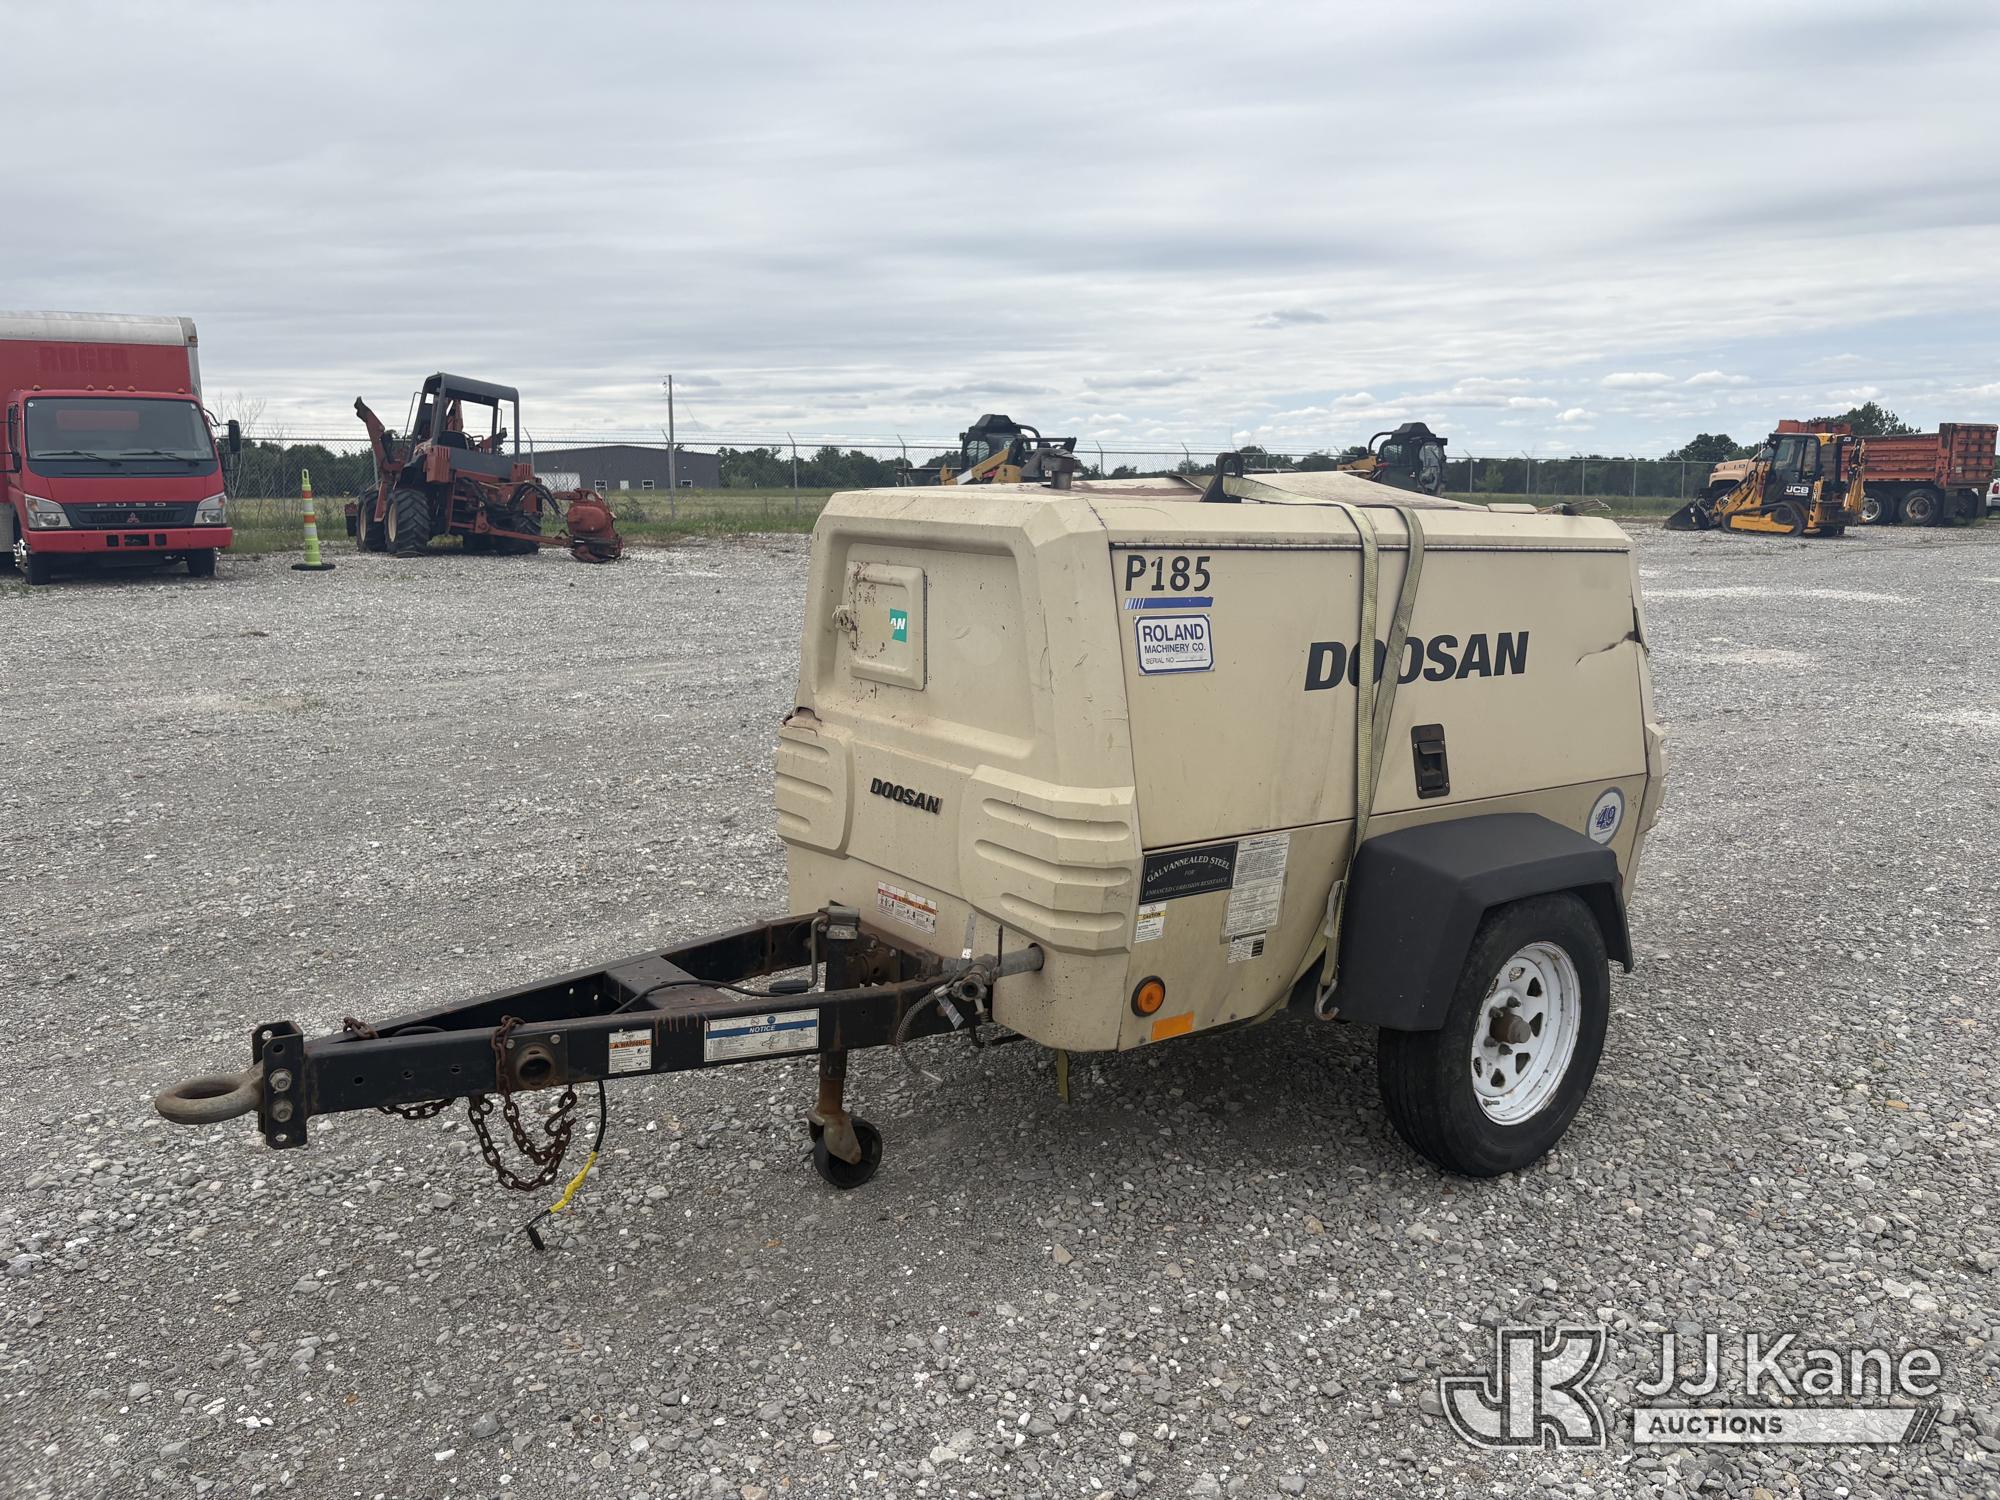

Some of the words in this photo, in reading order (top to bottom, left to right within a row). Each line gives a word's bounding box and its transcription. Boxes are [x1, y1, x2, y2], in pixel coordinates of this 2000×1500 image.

[1785, 485, 1809, 494] JCB
[1125, 554, 1211, 592] P185
[1142, 623, 1204, 643] ROLAND
[1144, 642, 1190, 654] MACHINERY
[1192, 642, 1206, 652] CO.
[1145, 657, 1165, 665] SERIAL
[869, 777, 943, 814] DOOSAN
[1209, 856, 1231, 870] STEEL
[1142, 911, 1162, 920] CAUTION
[748, 1025, 777, 1034] NOTICE
[620, 1039, 647, 1048] WARNING
